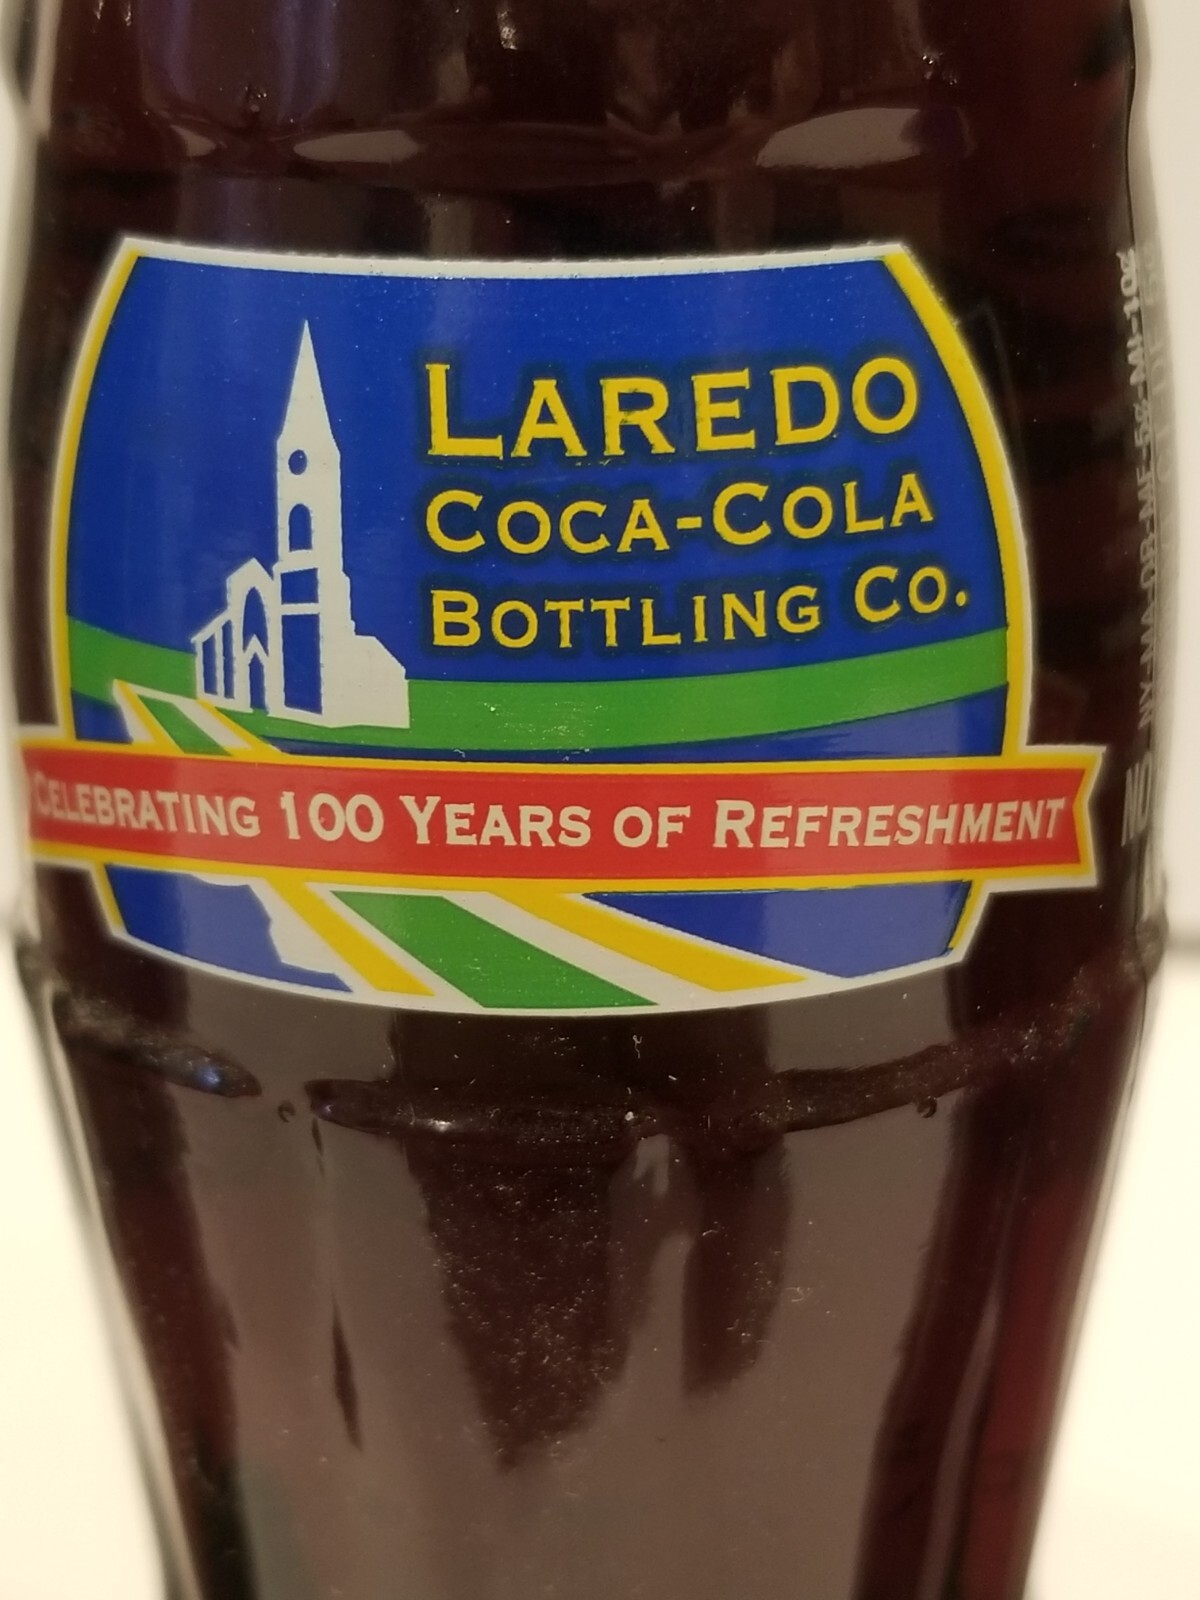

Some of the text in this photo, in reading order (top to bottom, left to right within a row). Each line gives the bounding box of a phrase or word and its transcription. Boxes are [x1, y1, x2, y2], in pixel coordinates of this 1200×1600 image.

[425, 356, 918, 459] LAREDO
[425, 473, 934, 555] COCA-COLA
[430, 565, 969, 649] BOTTLING CO.
[32, 769, 1067, 849] CELEBRATING 100 YEARS OF REFRESHMENT
